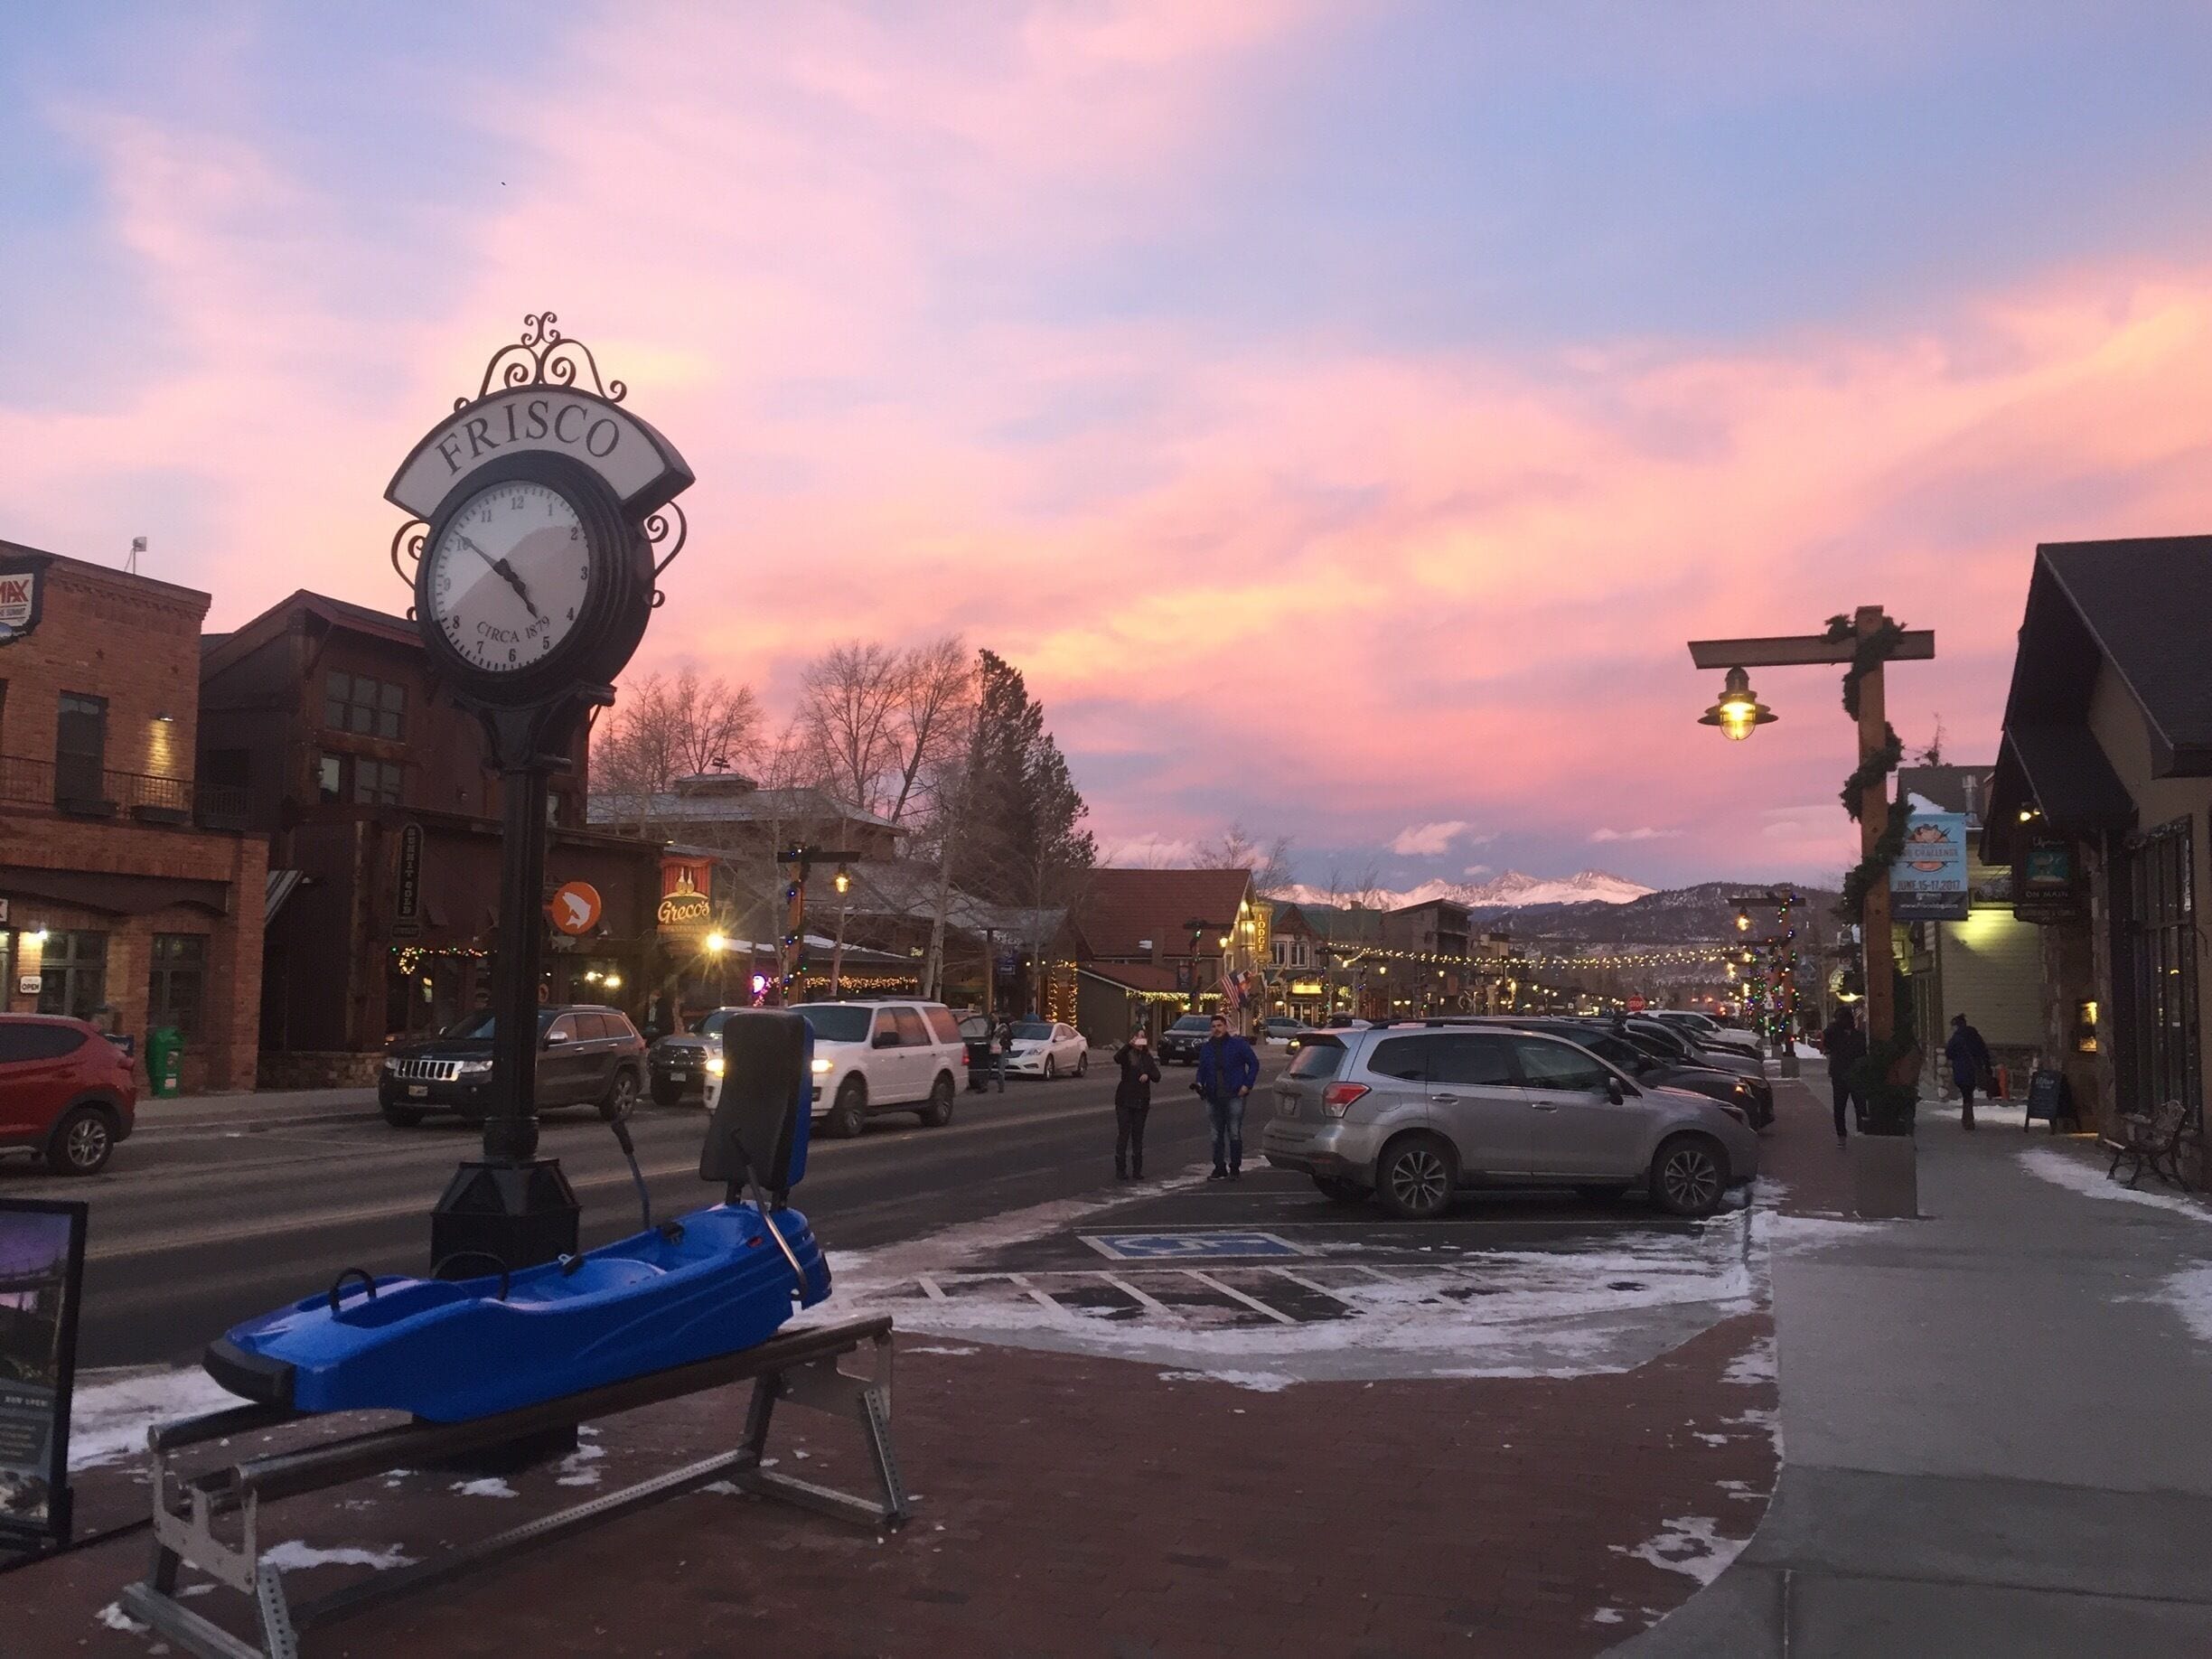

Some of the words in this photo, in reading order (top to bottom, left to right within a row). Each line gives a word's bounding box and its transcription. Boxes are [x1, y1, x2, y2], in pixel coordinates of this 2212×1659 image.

[435, 399, 620, 476] FRISCO
[511, 496, 524, 510] 12
[547, 502, 553, 516] 1
[481, 510, 492, 522] 11
[570, 527, 578, 540] 2
[580, 567, 587, 580] 3
[443, 577, 451, 591] 9
[567, 607, 574, 621] 4
[453, 615, 460, 629] 8
[476, 621, 520, 642] CIRCA
[525, 616, 550, 640] 1879
[477, 641, 484, 654] 7
[543, 636, 550, 650] 5
[509, 649, 516, 662] 6
[658, 901, 710, 923] Greco's
[1258, 914, 1266, 952] LODGE
